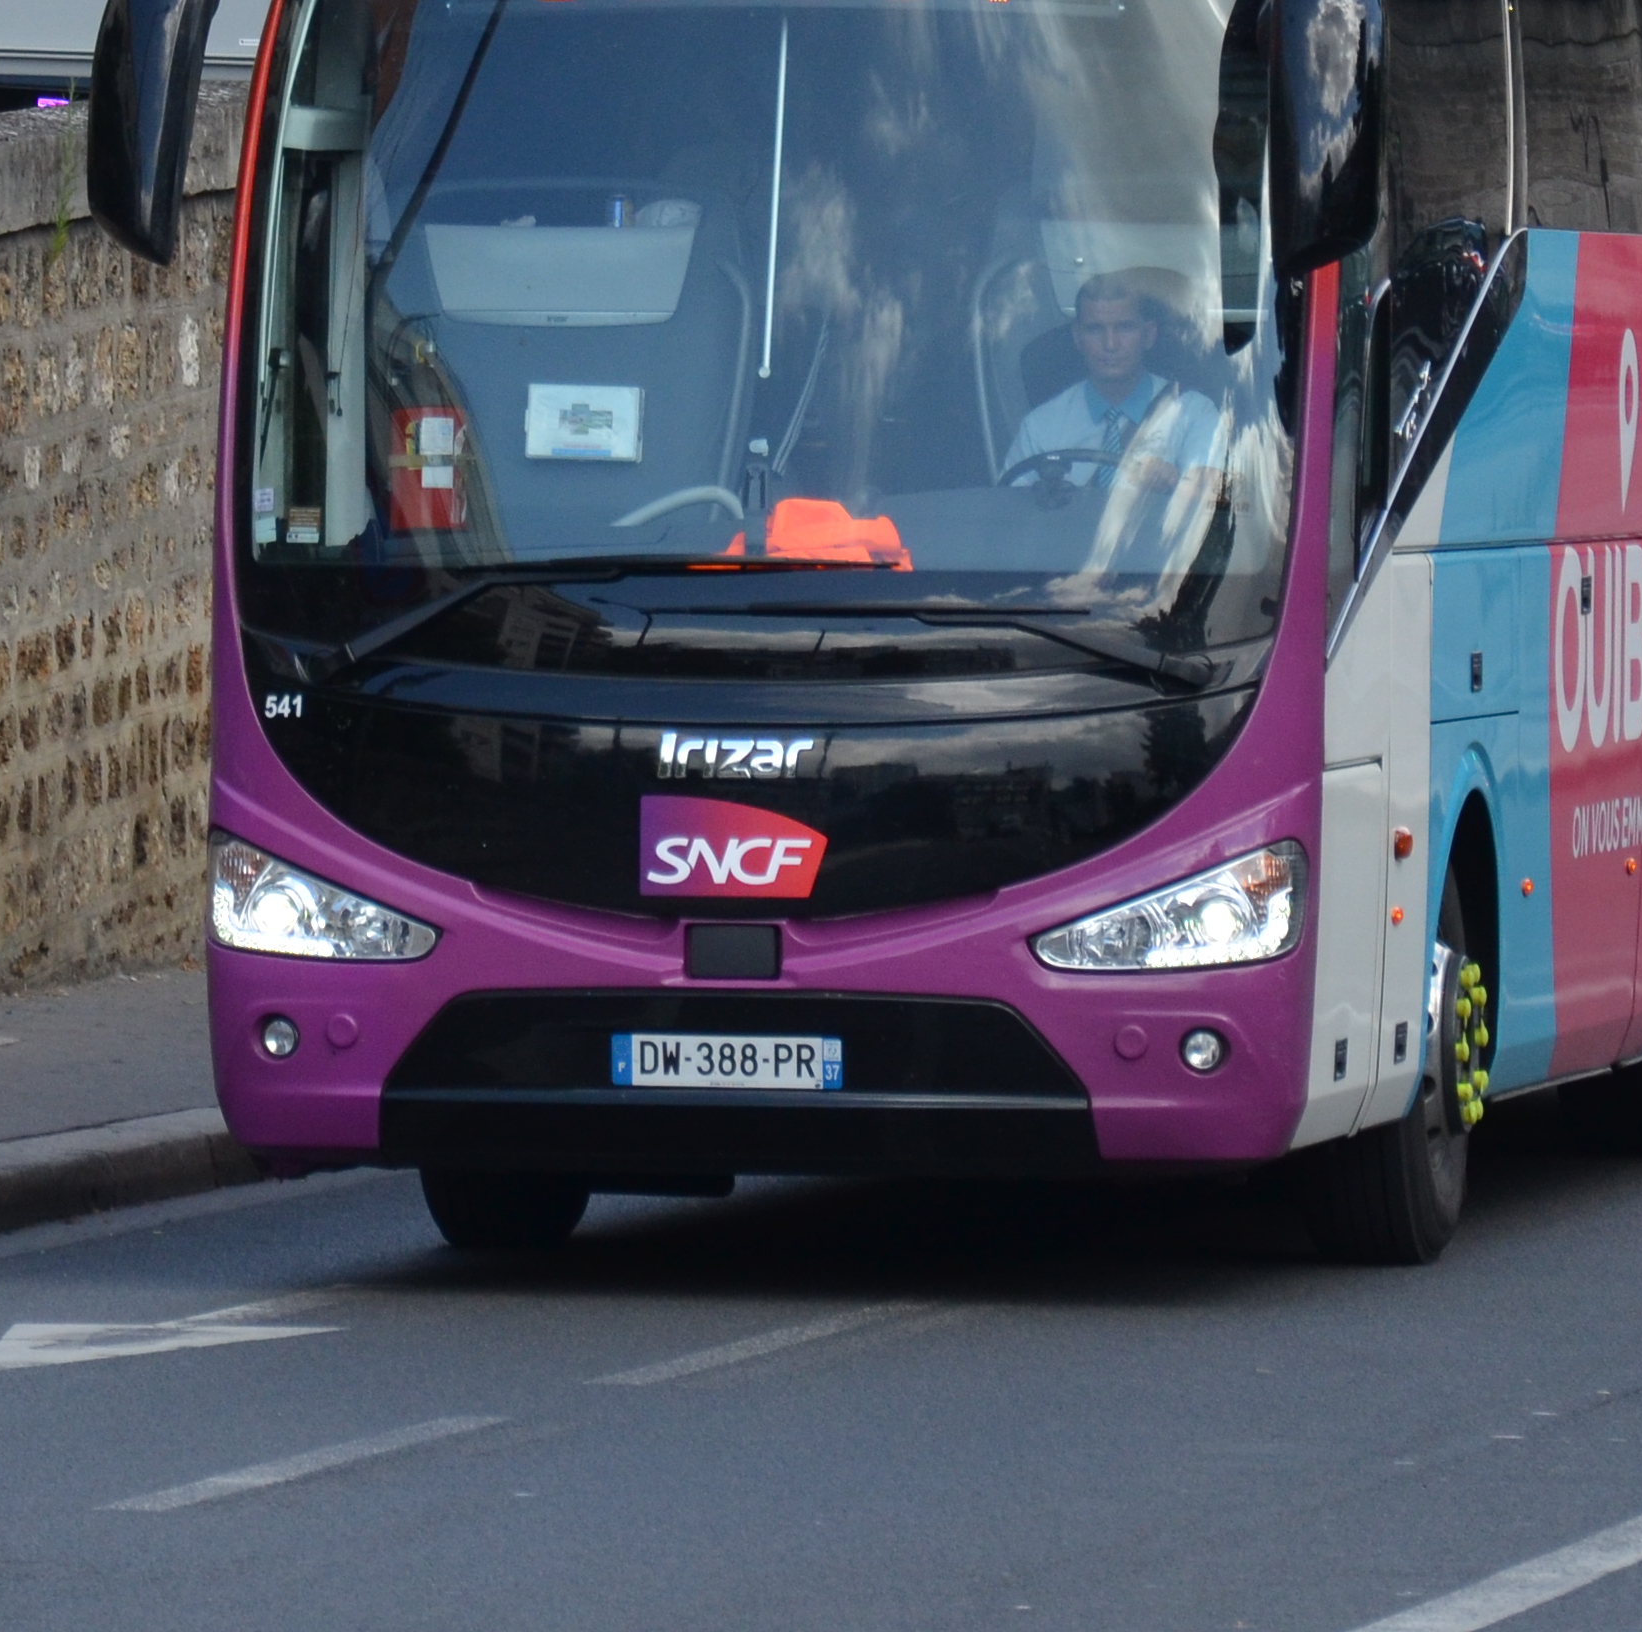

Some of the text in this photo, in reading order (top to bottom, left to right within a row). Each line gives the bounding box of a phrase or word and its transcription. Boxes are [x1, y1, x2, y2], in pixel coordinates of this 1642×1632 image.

[265, 694, 302, 718] 541
[658, 732, 814, 779] Irizar
[1572, 806, 1590, 859] ON
[1592, 798, 1620, 854] VOUS
[647, 837, 812, 885] SNCF
[618, 1063, 625, 1073] F
[639, 1041, 840, 1081] DW-388-PR 37
